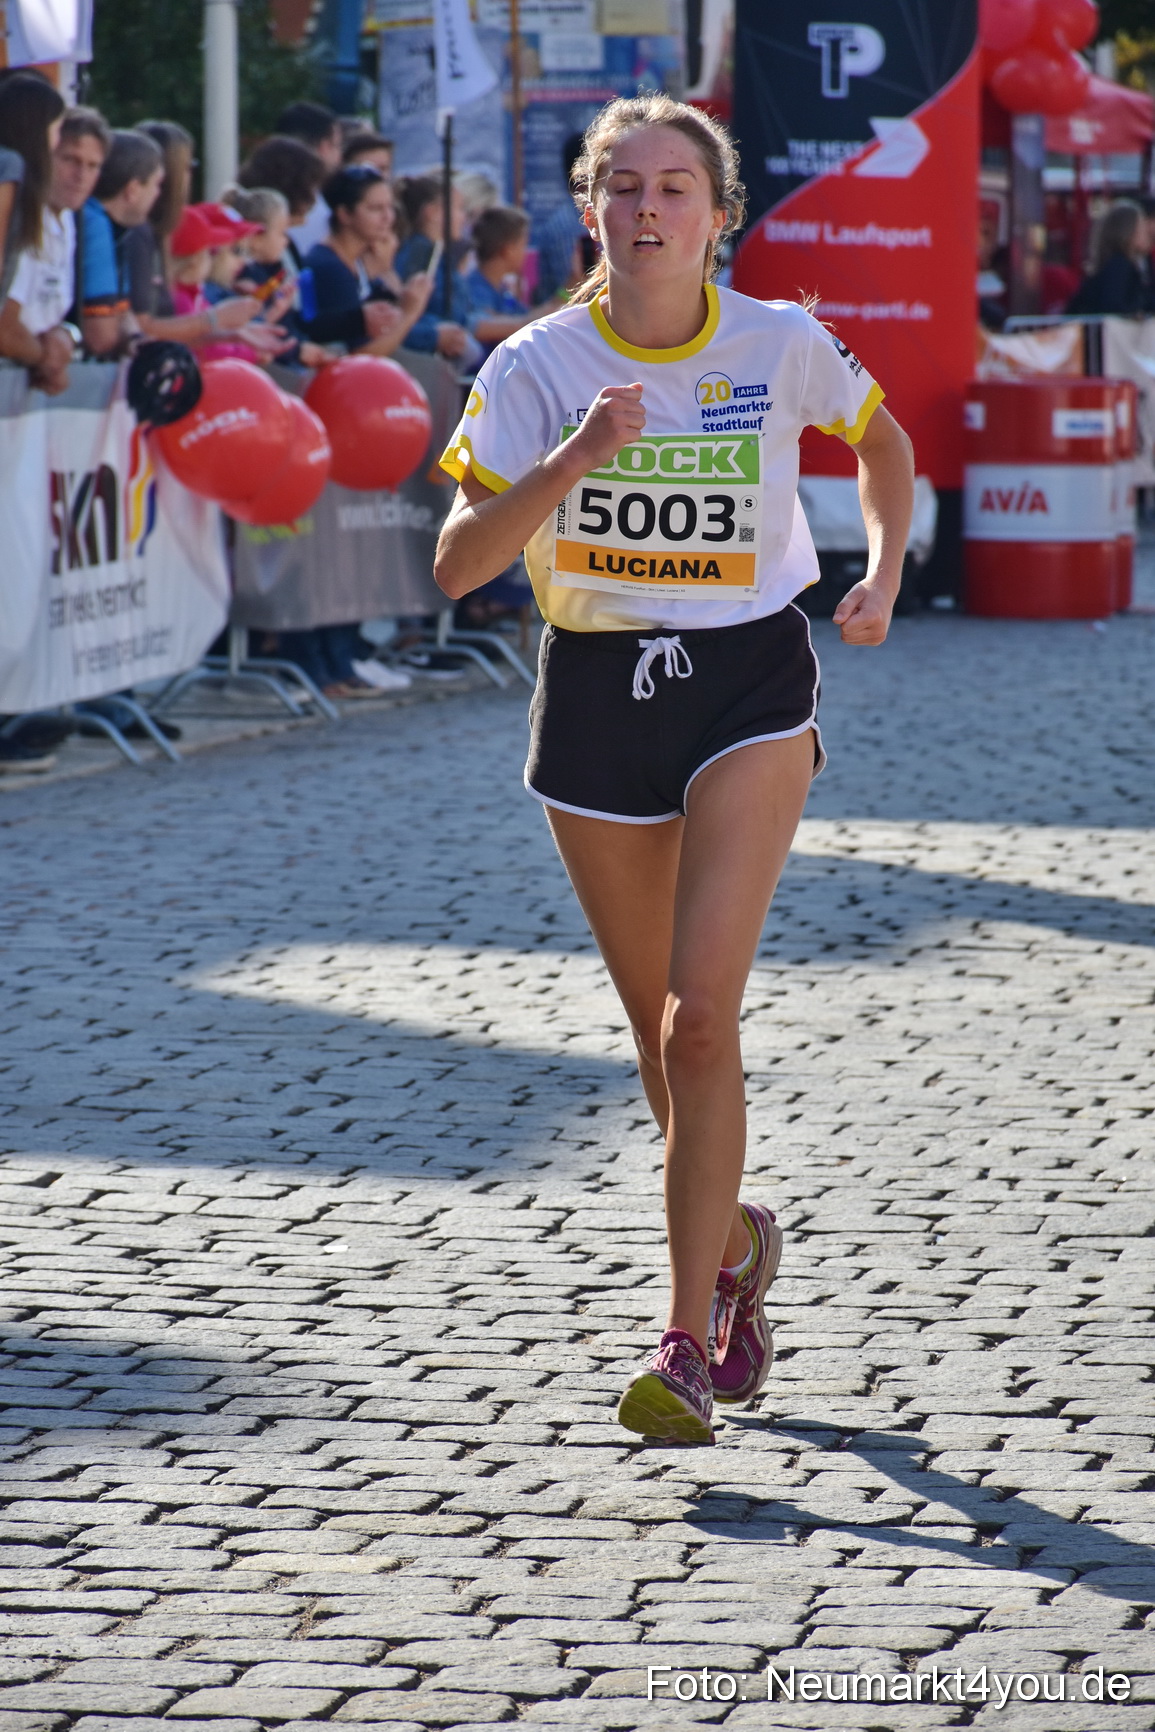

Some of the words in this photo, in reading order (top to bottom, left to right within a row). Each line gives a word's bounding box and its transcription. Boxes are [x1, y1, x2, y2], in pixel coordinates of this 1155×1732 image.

[764, 219, 819, 243] BMW
[823, 222, 933, 250] Laufsport
[699, 380, 731, 405] 20
[736, 386, 765, 398] JAHRE
[702, 416, 765, 432] Stadtlauf
[578, 487, 736, 542] 5003
[744, 498, 753, 508] S
[588, 551, 722, 580] LUCIANA
